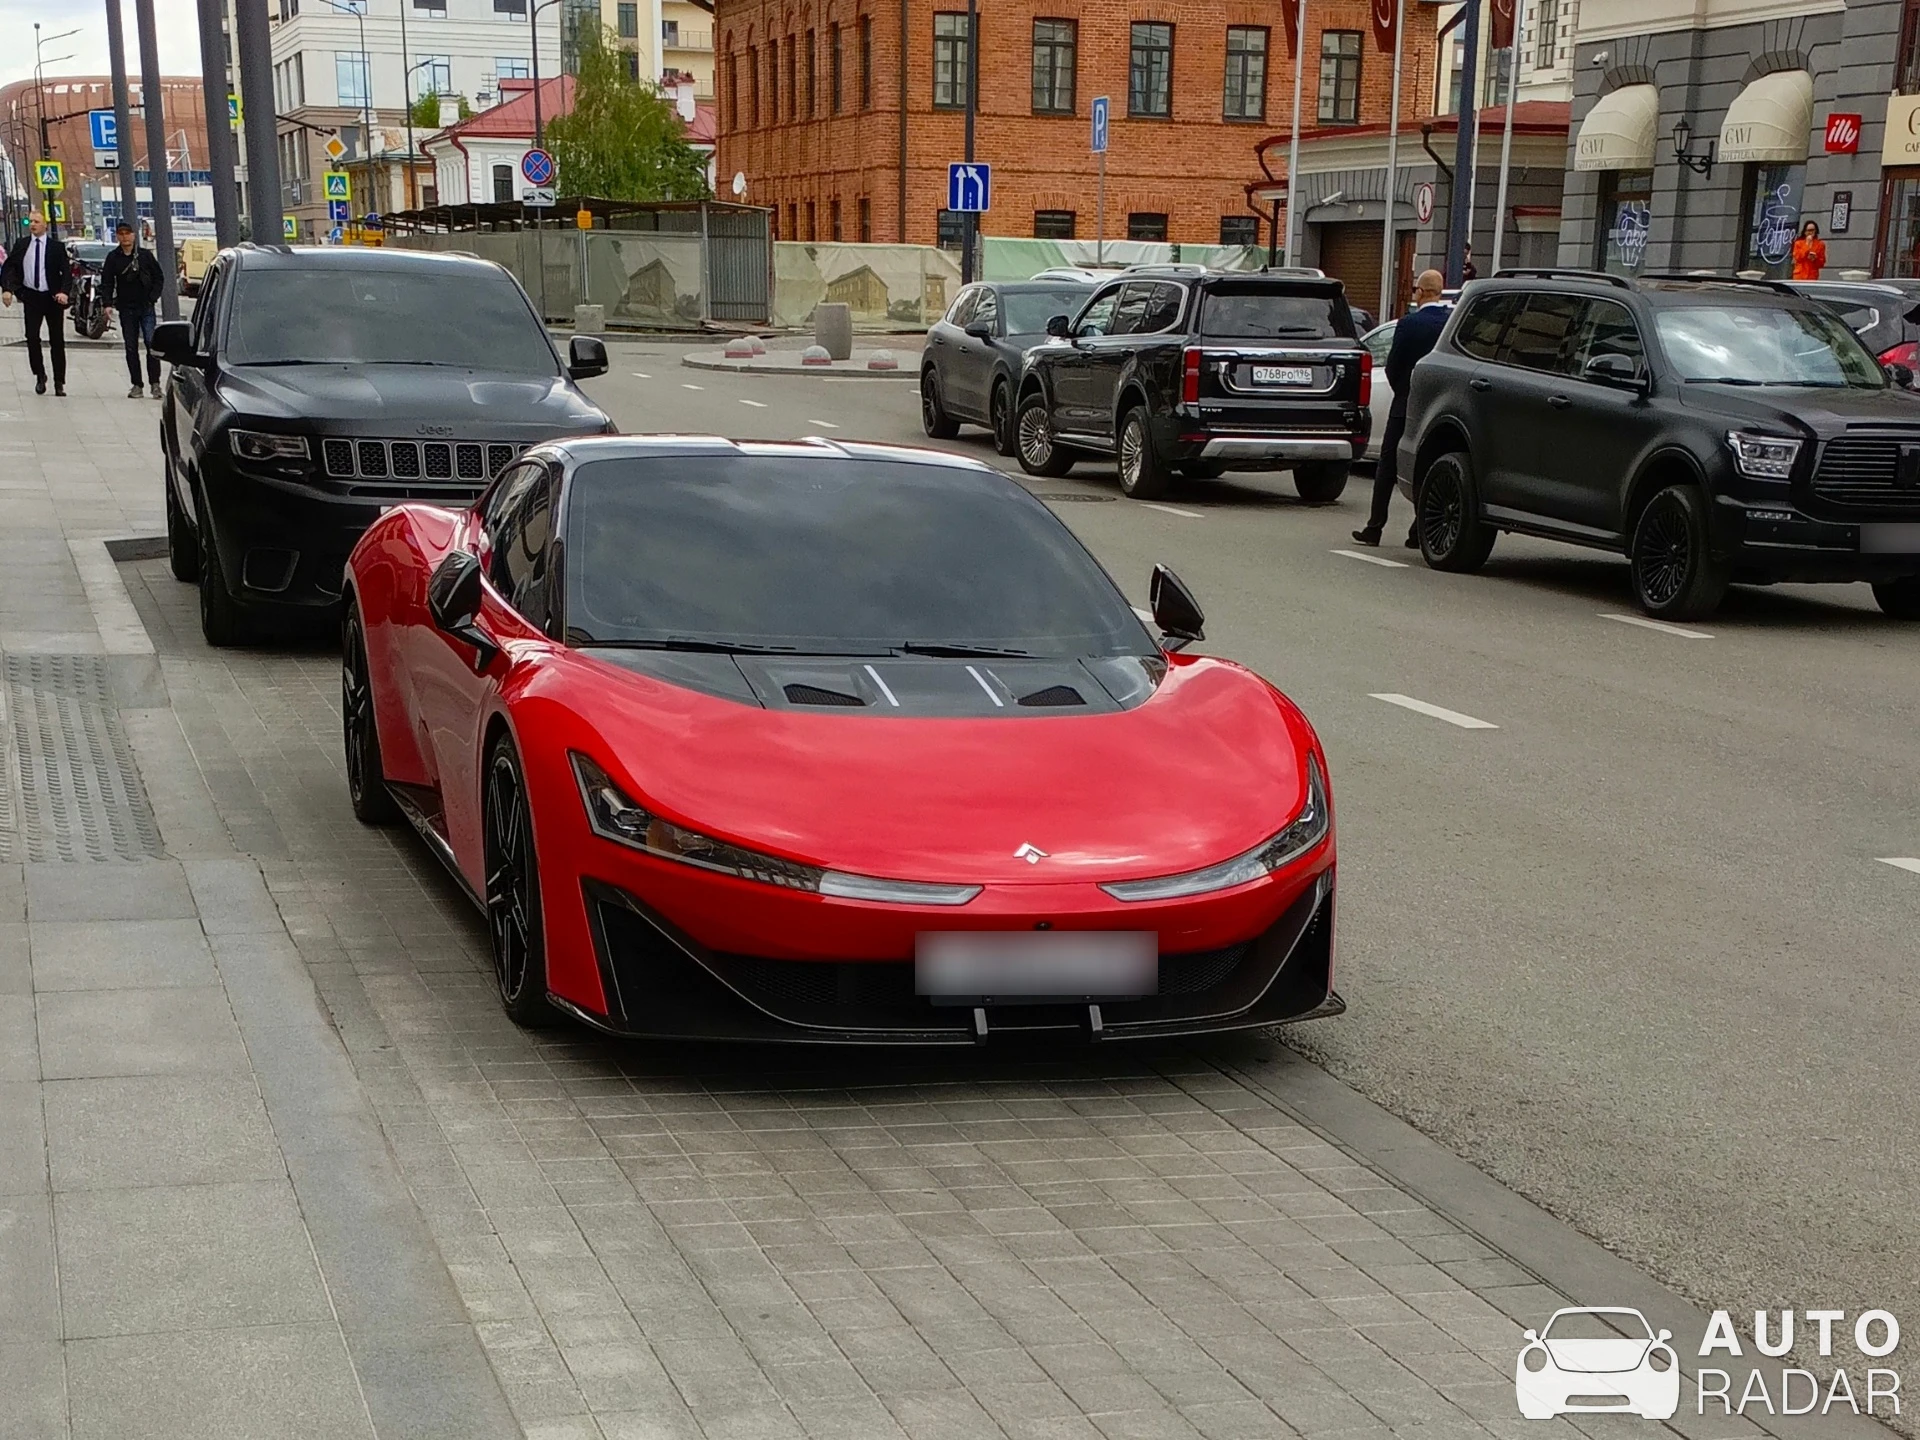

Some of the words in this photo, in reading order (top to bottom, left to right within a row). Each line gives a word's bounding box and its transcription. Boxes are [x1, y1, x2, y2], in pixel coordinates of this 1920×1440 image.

[100, 115, 117, 144] P
[1096, 104, 1105, 145] P
[1828, 118, 1858, 149] illy
[1616, 213, 1648, 248] Cake
[1757, 218, 1797, 254] Coffee
[416, 424, 454, 437] Jeep
